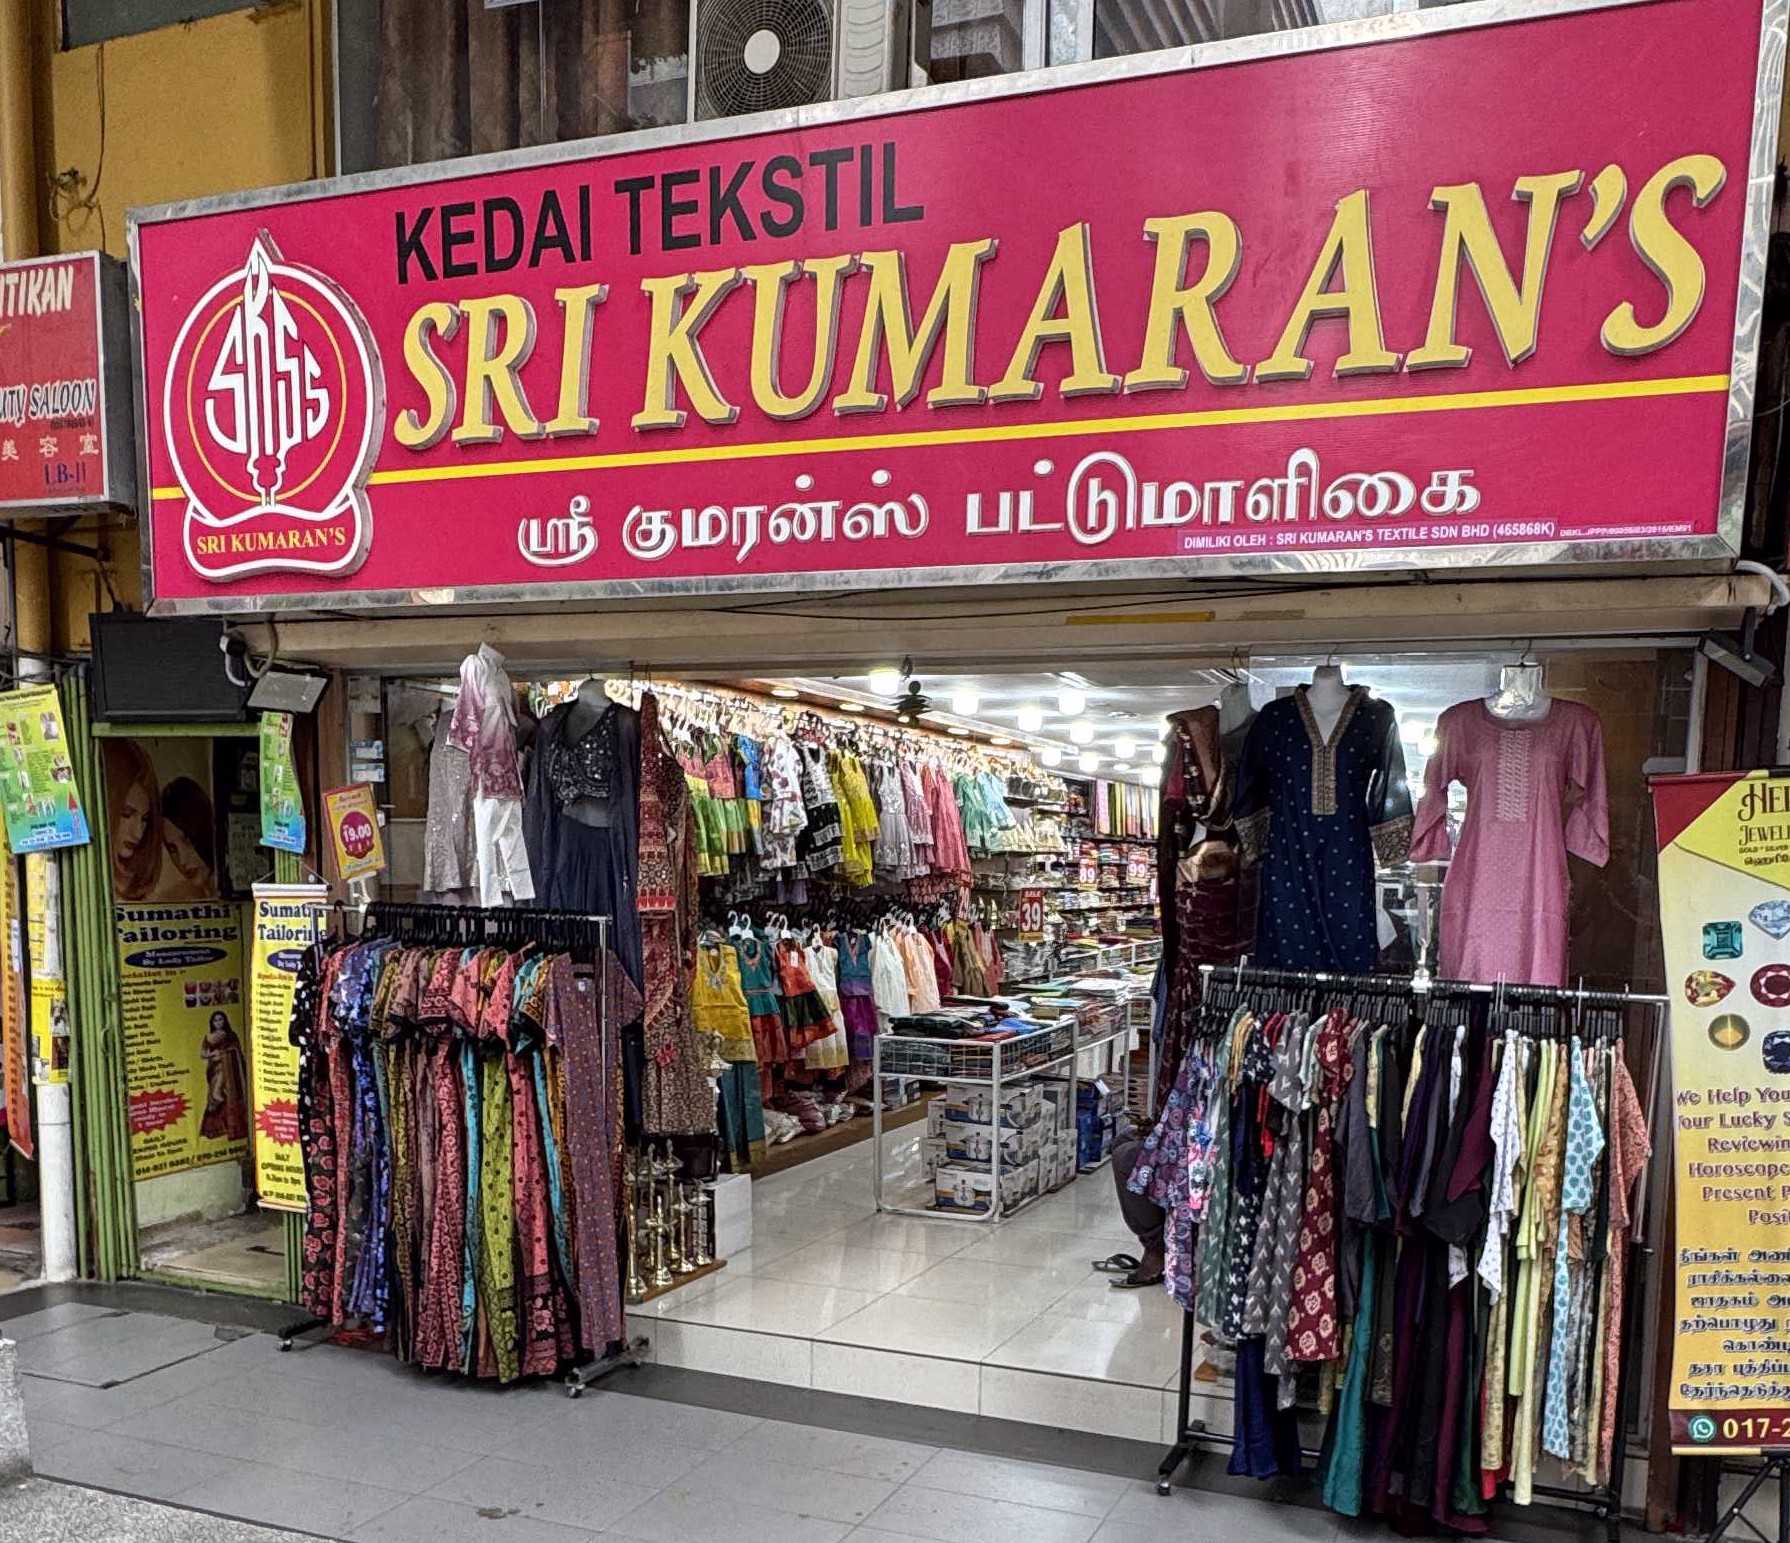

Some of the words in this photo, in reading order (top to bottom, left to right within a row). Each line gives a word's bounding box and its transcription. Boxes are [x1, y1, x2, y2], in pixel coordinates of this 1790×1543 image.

[395, 185, 592, 285] KEDAI
[615, 142, 924, 257] TEKSTIL
[393, 283, 610, 450] SRI
[631, 153, 1727, 434] KUMARAN'S
[29, 379, 97, 418] SALOON
[622, 468, 929, 564] குமரன்ஸ்
[966, 447, 1482, 545] பட்டுமாளிகை
[197, 533, 226, 556] SRI
[230, 526, 347, 553] KUMARAN'S
[1184, 535, 1231, 549] DIMILIKI
[1233, 534, 1266, 546] OLEH
[1276, 532, 1297, 545] SRI
[1299, 529, 1373, 544] KUMARAN'S
[1377, 527, 1429, 541] TEXTILE
[1431, 524, 1458, 539] SDN
[1461, 523, 1489, 538] BHD
[1492, 521, 1555, 538] (465868K)
[1021, 901, 1042, 932] 39
[1707, 1087, 1752, 1108] Help
[1719, 1111, 1778, 1131] Lucky
[1703, 1185, 1777, 1202] Present
[1723, 1417, 1790, 1440] 017-2
